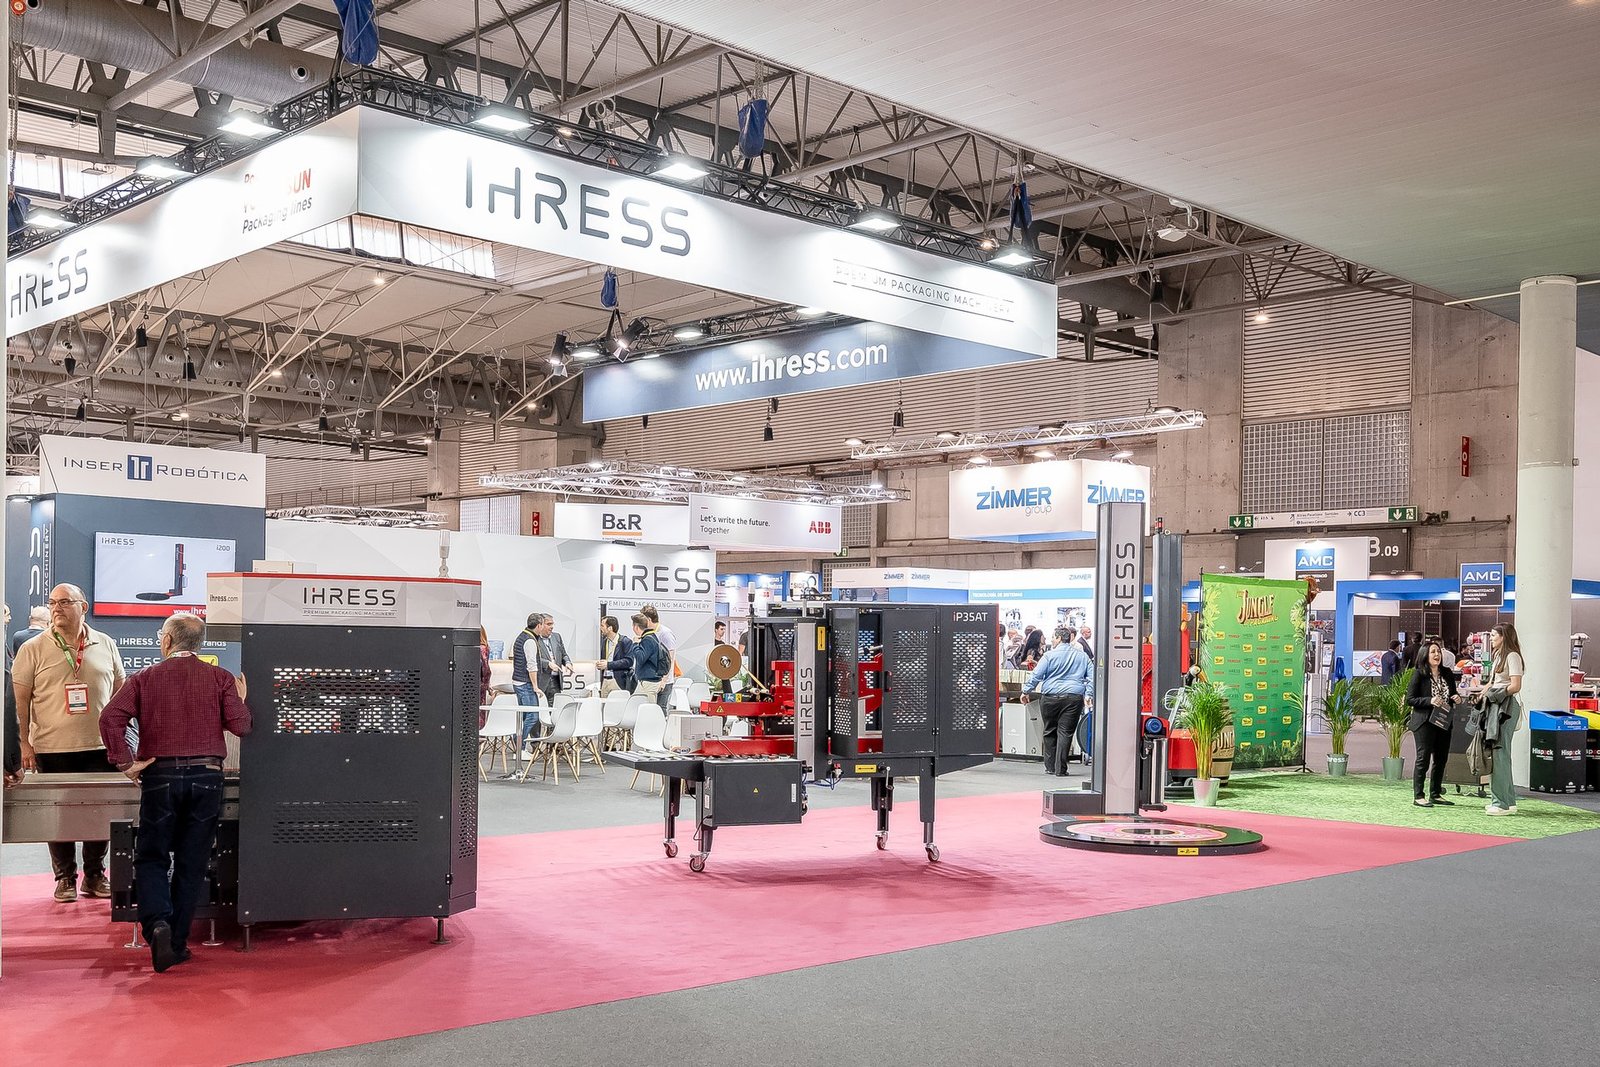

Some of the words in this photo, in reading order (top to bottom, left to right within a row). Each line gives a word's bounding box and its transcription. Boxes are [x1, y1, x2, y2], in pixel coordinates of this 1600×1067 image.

[465, 155, 691, 257] IHRESS
[891, 279, 950, 302] PACKAGING
[695, 343, 888, 391] www.ihress.com
[1024, 506, 1052, 517] group
[602, 513, 642, 530] B&R
[700, 514, 716, 523] Let's
[736, 517, 748, 525] the
[748, 518, 771, 527] future.
[700, 525, 730, 535] Together
[808, 521, 832, 535] ABB
[101, 537, 136, 546] IHRESS
[1297, 555, 1334, 567] AMC
[600, 563, 711, 594] IHRESS
[1463, 571, 1501, 582] AMC
[209, 594, 239, 602] ihress.com
[303, 587, 396, 606] IHRESS
[1114, 542, 1135, 650] IHRESS
[173, 606, 206, 615] www.ihre
[953, 611, 988, 622] iP35AT
[120, 637, 153, 646] IHRESS
[1113, 659, 1134, 668] i200
[800, 666, 813, 737] IHRESS
